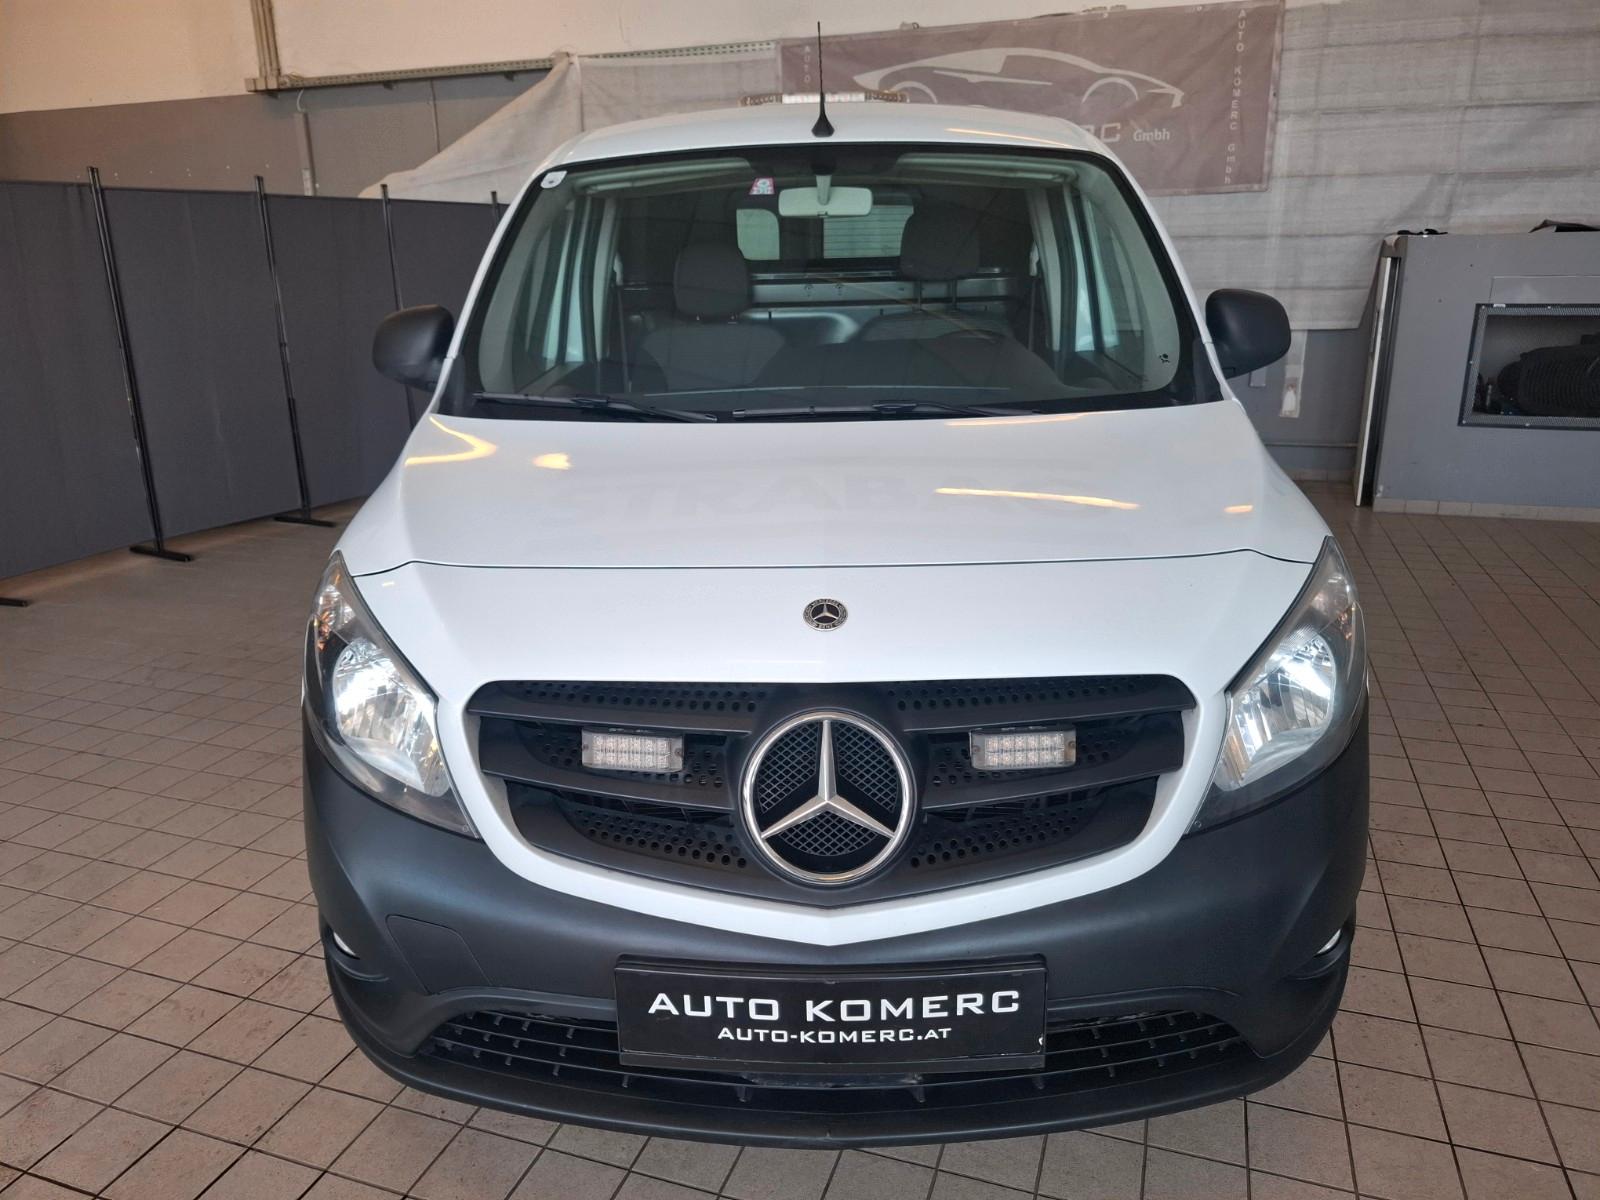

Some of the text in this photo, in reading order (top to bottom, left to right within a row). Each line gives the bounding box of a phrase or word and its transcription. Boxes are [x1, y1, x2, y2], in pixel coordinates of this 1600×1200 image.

[1236, 8, 1247, 52] AUTO
[1229, 65, 1241, 130] KOMERC
[1133, 128, 1171, 142] Gmbh
[648, 990, 1021, 1022] AUTO KOMERC
[716, 1027, 953, 1044] AUTO-KOMERC.AT
